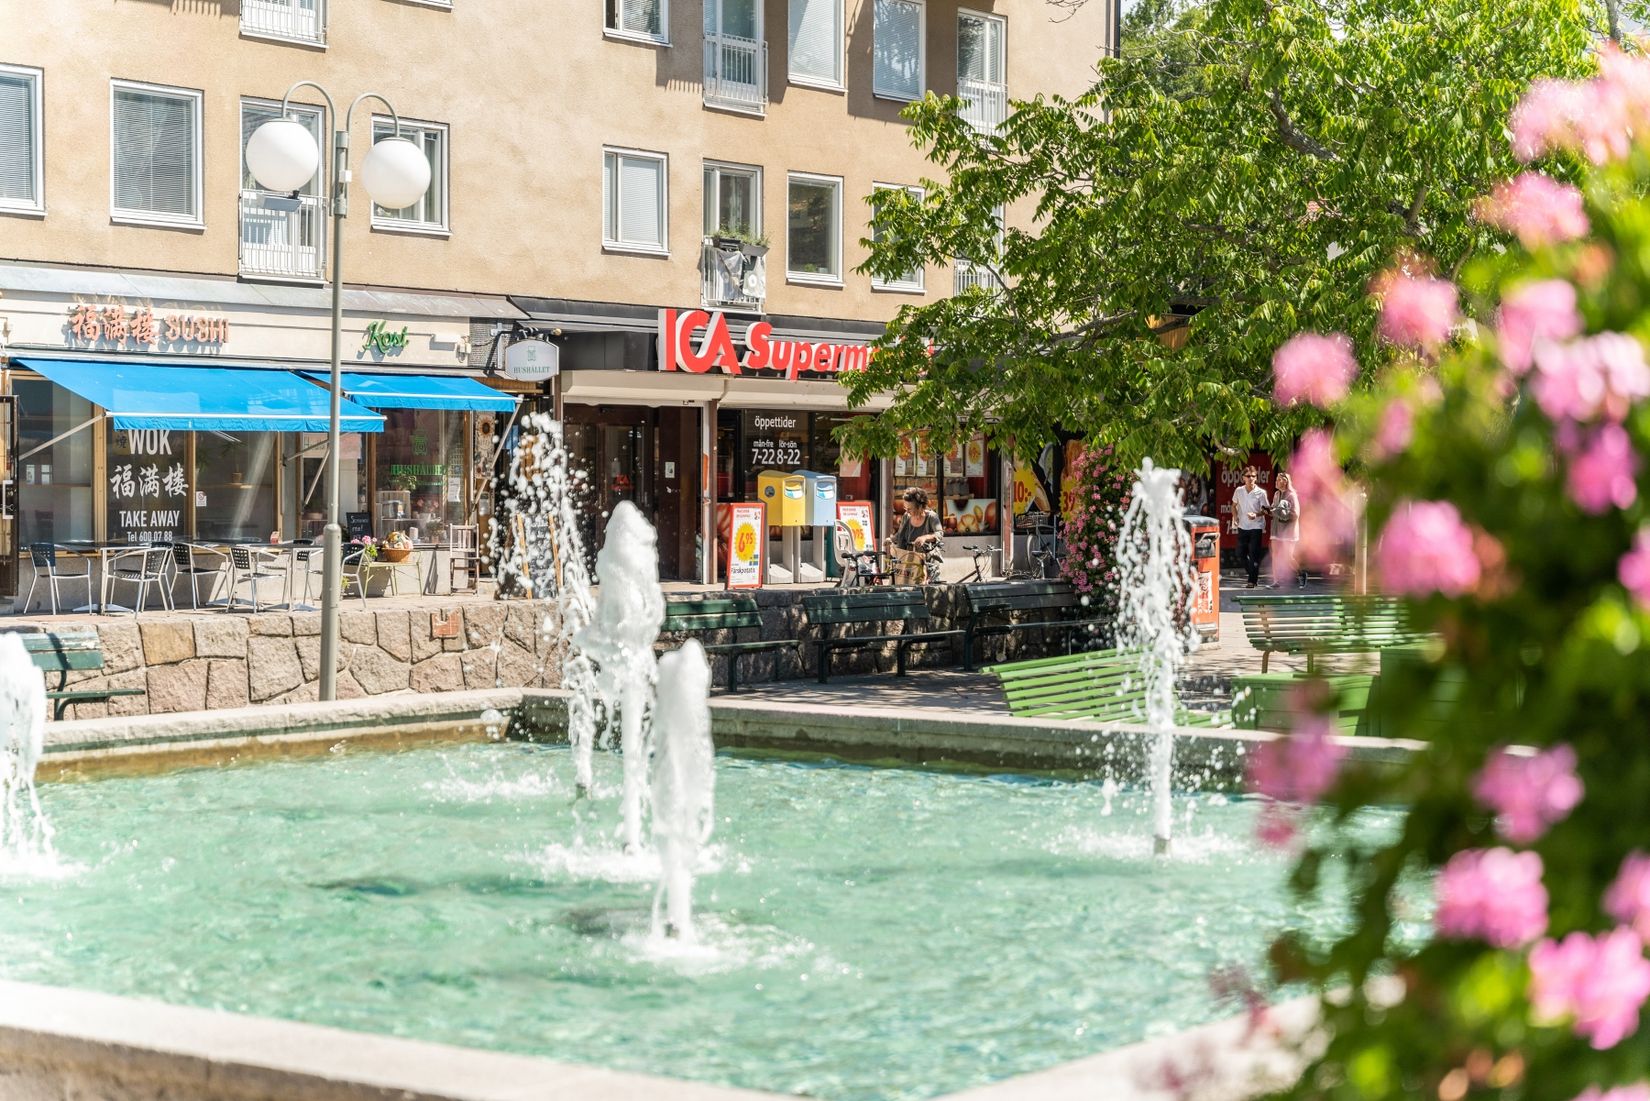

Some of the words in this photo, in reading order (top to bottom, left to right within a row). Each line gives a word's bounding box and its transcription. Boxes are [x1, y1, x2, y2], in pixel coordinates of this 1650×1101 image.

[165, 314, 230, 343] SUSHI
[658, 308, 742, 375] ICA
[745, 321, 935, 381] Superm
[754, 415, 796, 430] öppettider
[128, 430, 172, 455] WOK
[751, 448, 775, 465] 7-22
[776, 448, 801, 465] 8-22
[119, 510, 148, 527] TAKE
[150, 510, 180, 527] AWAY
[127, 531, 137, 542] Tel
[139, 531, 152, 542] 600
[164, 531, 173, 542] 88
